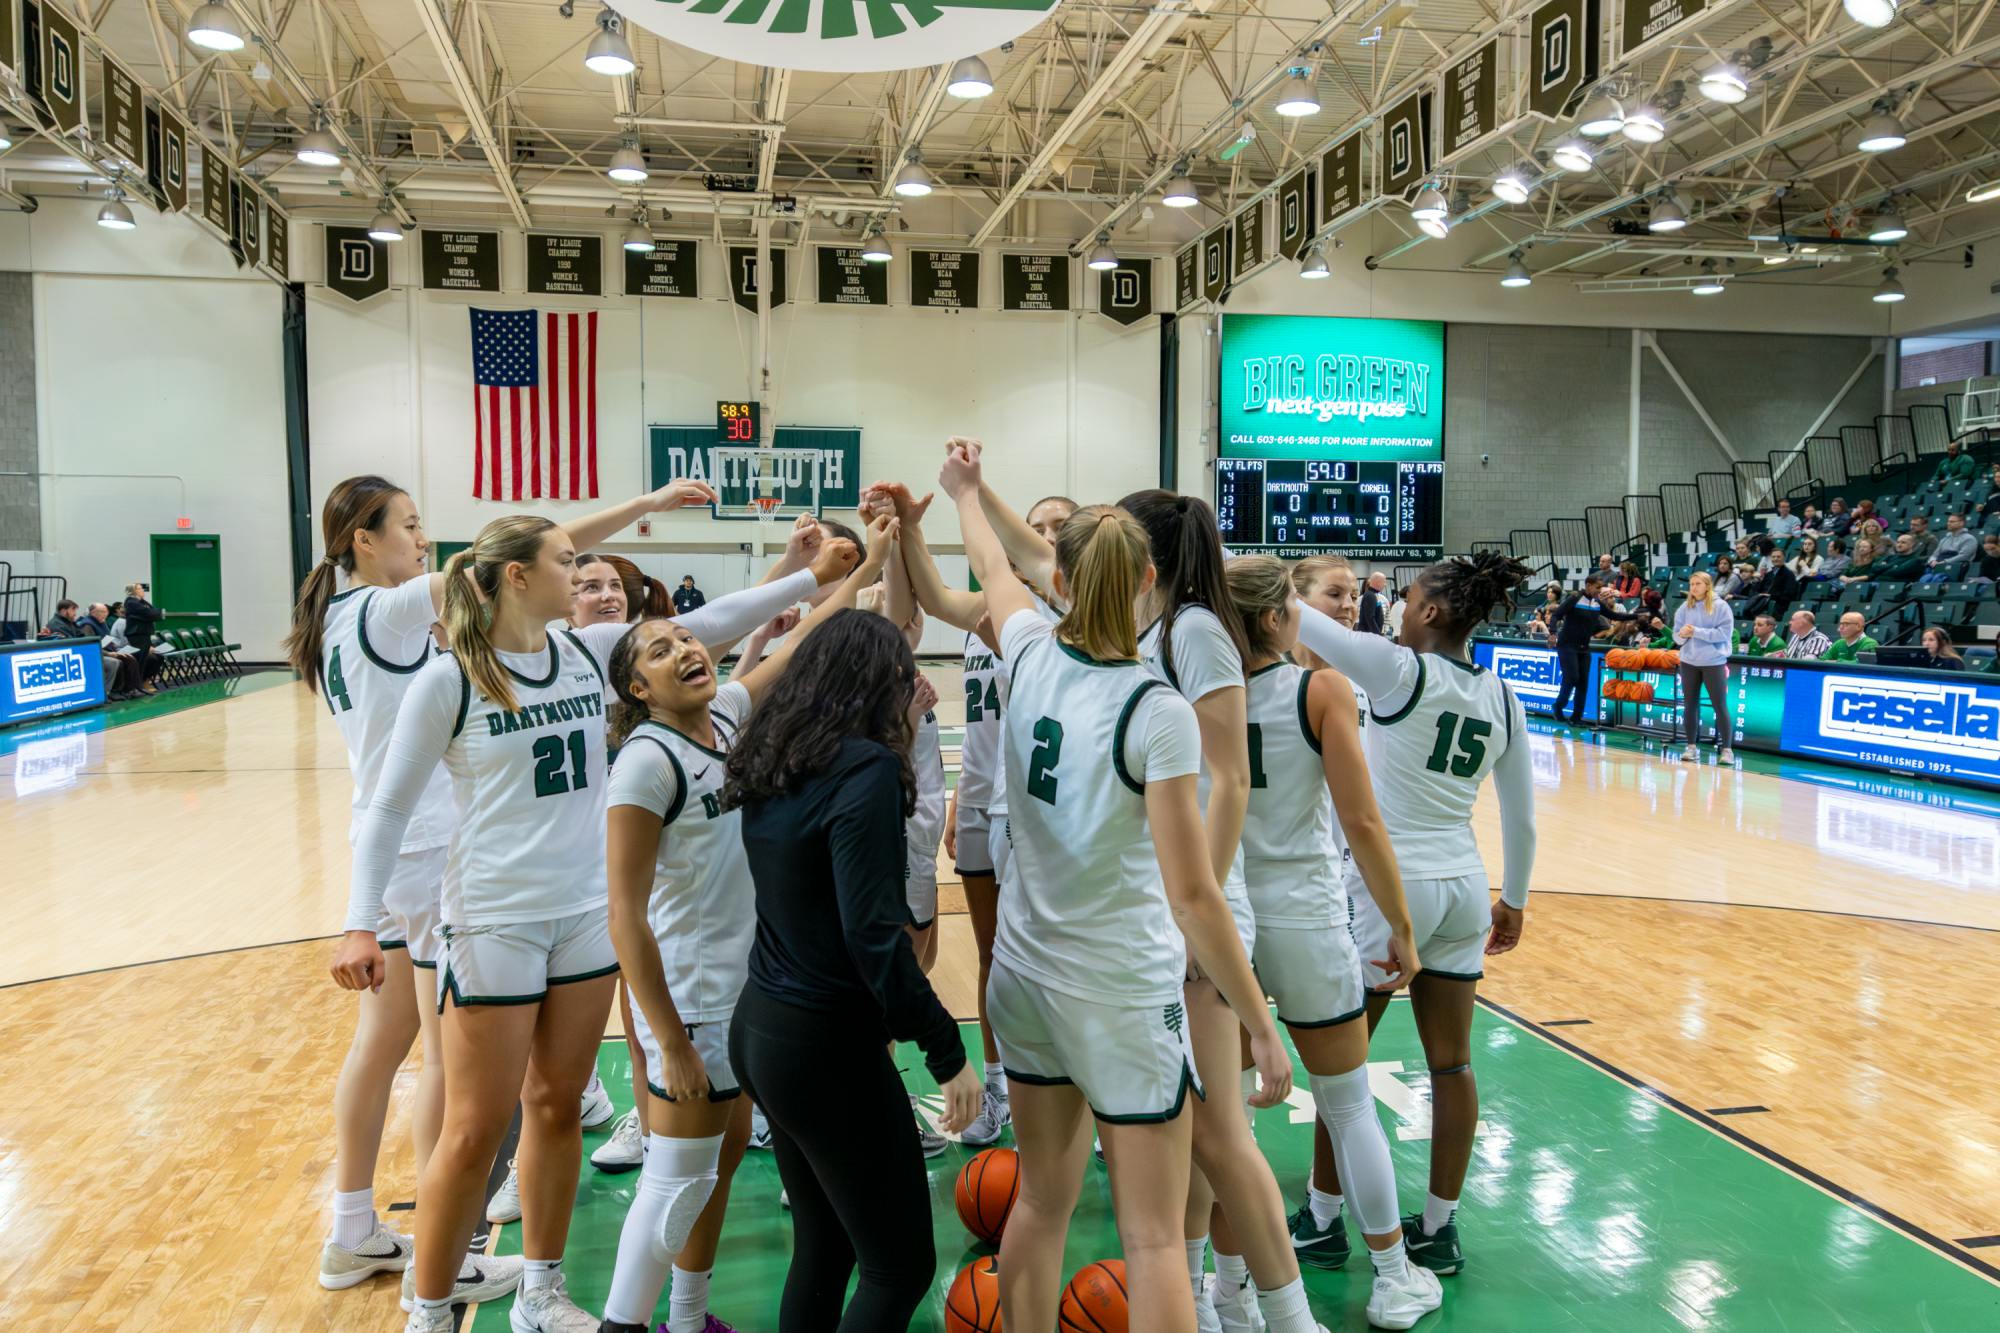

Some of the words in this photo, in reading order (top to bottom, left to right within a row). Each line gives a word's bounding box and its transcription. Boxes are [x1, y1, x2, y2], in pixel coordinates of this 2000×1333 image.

[1642, 5, 1683, 40] BASKETBALL
[1541, 12, 1570, 92] D
[50, 26, 73, 104] D
[1390, 117, 1411, 180] D
[167, 127, 181, 189] D
[1284, 189, 1299, 241] D
[244, 197, 256, 248] D
[442, 234, 453, 243] IVY
[456, 235, 479, 243] LEAGUE
[547, 238, 557, 247] IVY
[559, 239, 581, 248] LEAGUE
[443, 244, 477, 253] CHAMPIONS
[656, 242, 678, 251] LEAGUE
[548, 248, 581, 257] CHAMPIONS
[645, 250, 676, 261] CHAMPIONS
[836, 249, 846, 257] IVY
[929, 253, 940, 261] IVY
[941, 253, 962, 262] LEAGUE
[340, 239, 374, 281] D
[1020, 256, 1031, 264] IVY
[1033, 257, 1051, 265] LEAGUE
[1208, 242, 1220, 287] D
[931, 261, 960, 270] CHAMPIONS
[1021, 264, 1051, 273] CHAMPIONS
[448, 268, 474, 277] WOMEN'S
[552, 272, 578, 281] WOMEN'S
[442, 278, 481, 288] BASKETBALL
[649, 275, 673, 284] WOMEN'S
[545, 282, 583, 292] BASKETBALL
[642, 285, 680, 294] BASKETBALL
[842, 286, 865, 294] WOMEN'S
[1112, 269, 1140, 307] D
[836, 294, 870, 303] BASKETBALL
[934, 289, 957, 298] WOMEN'S
[1025, 293, 1048, 301] WOMEN'S
[928, 297, 961, 306] BASKETBALL
[1020, 300, 1053, 309] BASKETBALL
[1243, 354, 1305, 411] BIG
[1315, 354, 1430, 415] GREEN
[721, 404, 749, 418] 58.9
[727, 418, 753, 439] 30
[1230, 435, 1254, 444] CALL
[1322, 436, 1340, 446] FOR
[1342, 437, 1368, 446] MORE
[1370, 438, 1433, 447] INFORMATION
[1219, 461, 1234, 470] PLY
[1236, 461, 1246, 470] FL
[1247, 461, 1263, 471] PTS
[1400, 463, 1415, 472] PLY
[1417, 463, 1427, 473] FL
[1427, 464, 1443, 473] PTS
[1227, 472, 1234, 481] 4
[1308, 462, 1346, 481] 59.0
[1223, 484, 1234, 493] 11
[1266, 482, 1309, 493] DARTMOUTH
[1360, 484, 1390, 494] CORNELL
[1401, 485, 1415, 495] 21
[1223, 495, 1234, 505] 13
[1290, 494, 1300, 512] 0
[1379, 495, 1389, 513] 0
[1401, 497, 1415, 507] 22
[1220, 508, 1234, 517] 21
[1401, 509, 1415, 519] 32
[1220, 519, 1234, 530] 25
[1272, 516, 1287, 525] FLS
[1312, 516, 1330, 526] PLYR
[1334, 516, 1351, 526] FOUL
[1375, 517, 1390, 526] FLS
[1401, 521, 1415, 531] 33
[1277, 528, 1286, 542] 0
[1298, 529, 1306, 541] 4
[1357, 529, 1366, 541] 4
[1380, 529, 1389, 542] 0
[1260, 549, 1277, 557] THE
[1280, 549, 1319, 557] STEPHEN
[1376, 549, 1405, 557] FAMILY
[18, 653, 82, 690] casella
[328, 644, 353, 712] 4
[965, 676, 1001, 723] 24
[486, 691, 602, 737] DARTMOUTH
[1831, 691, 2000, 742] casella
[1427, 710, 1493, 779] 15
[532, 729, 588, 799] 21
[1027, 715, 1064, 806] 2
[1859, 751, 1925, 769] ESTABLISHED
[1928, 762, 1952, 773] 1975
